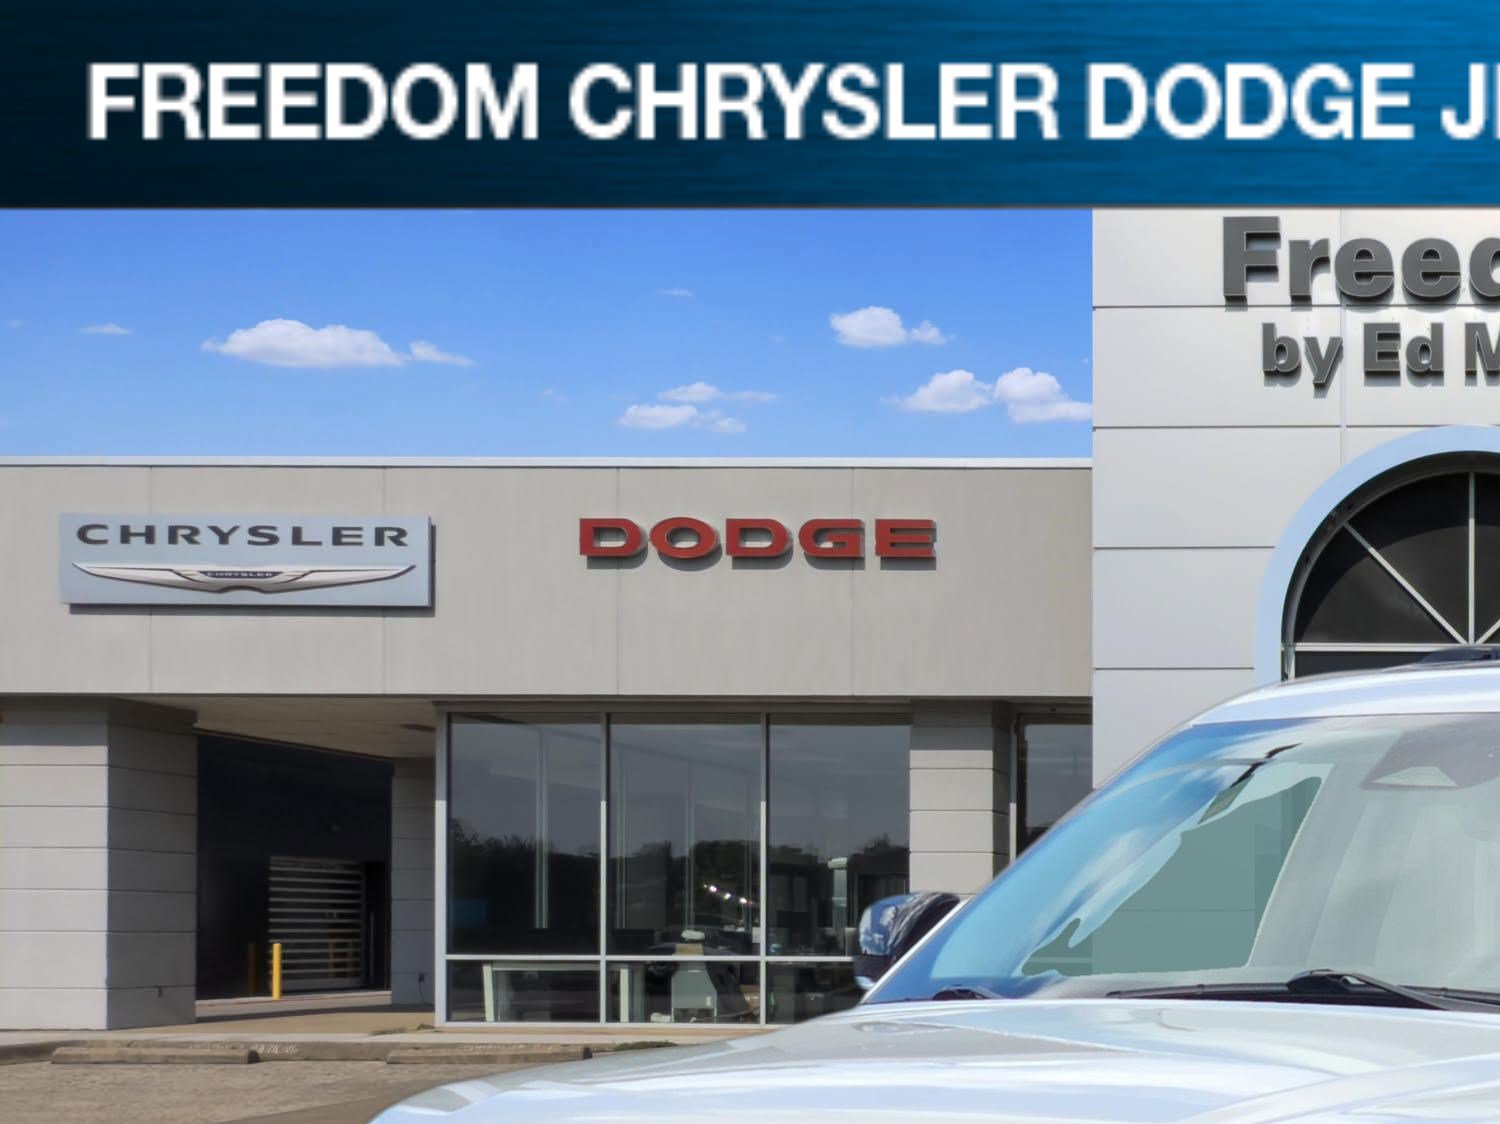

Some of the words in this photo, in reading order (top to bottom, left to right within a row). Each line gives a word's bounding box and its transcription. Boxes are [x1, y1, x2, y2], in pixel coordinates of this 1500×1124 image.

[1262, 322, 1343, 389] by
[1363, 322, 1444, 377] Ed
[76, 522, 408, 548] CHRYSLER
[579, 518, 934, 560] DODGE
